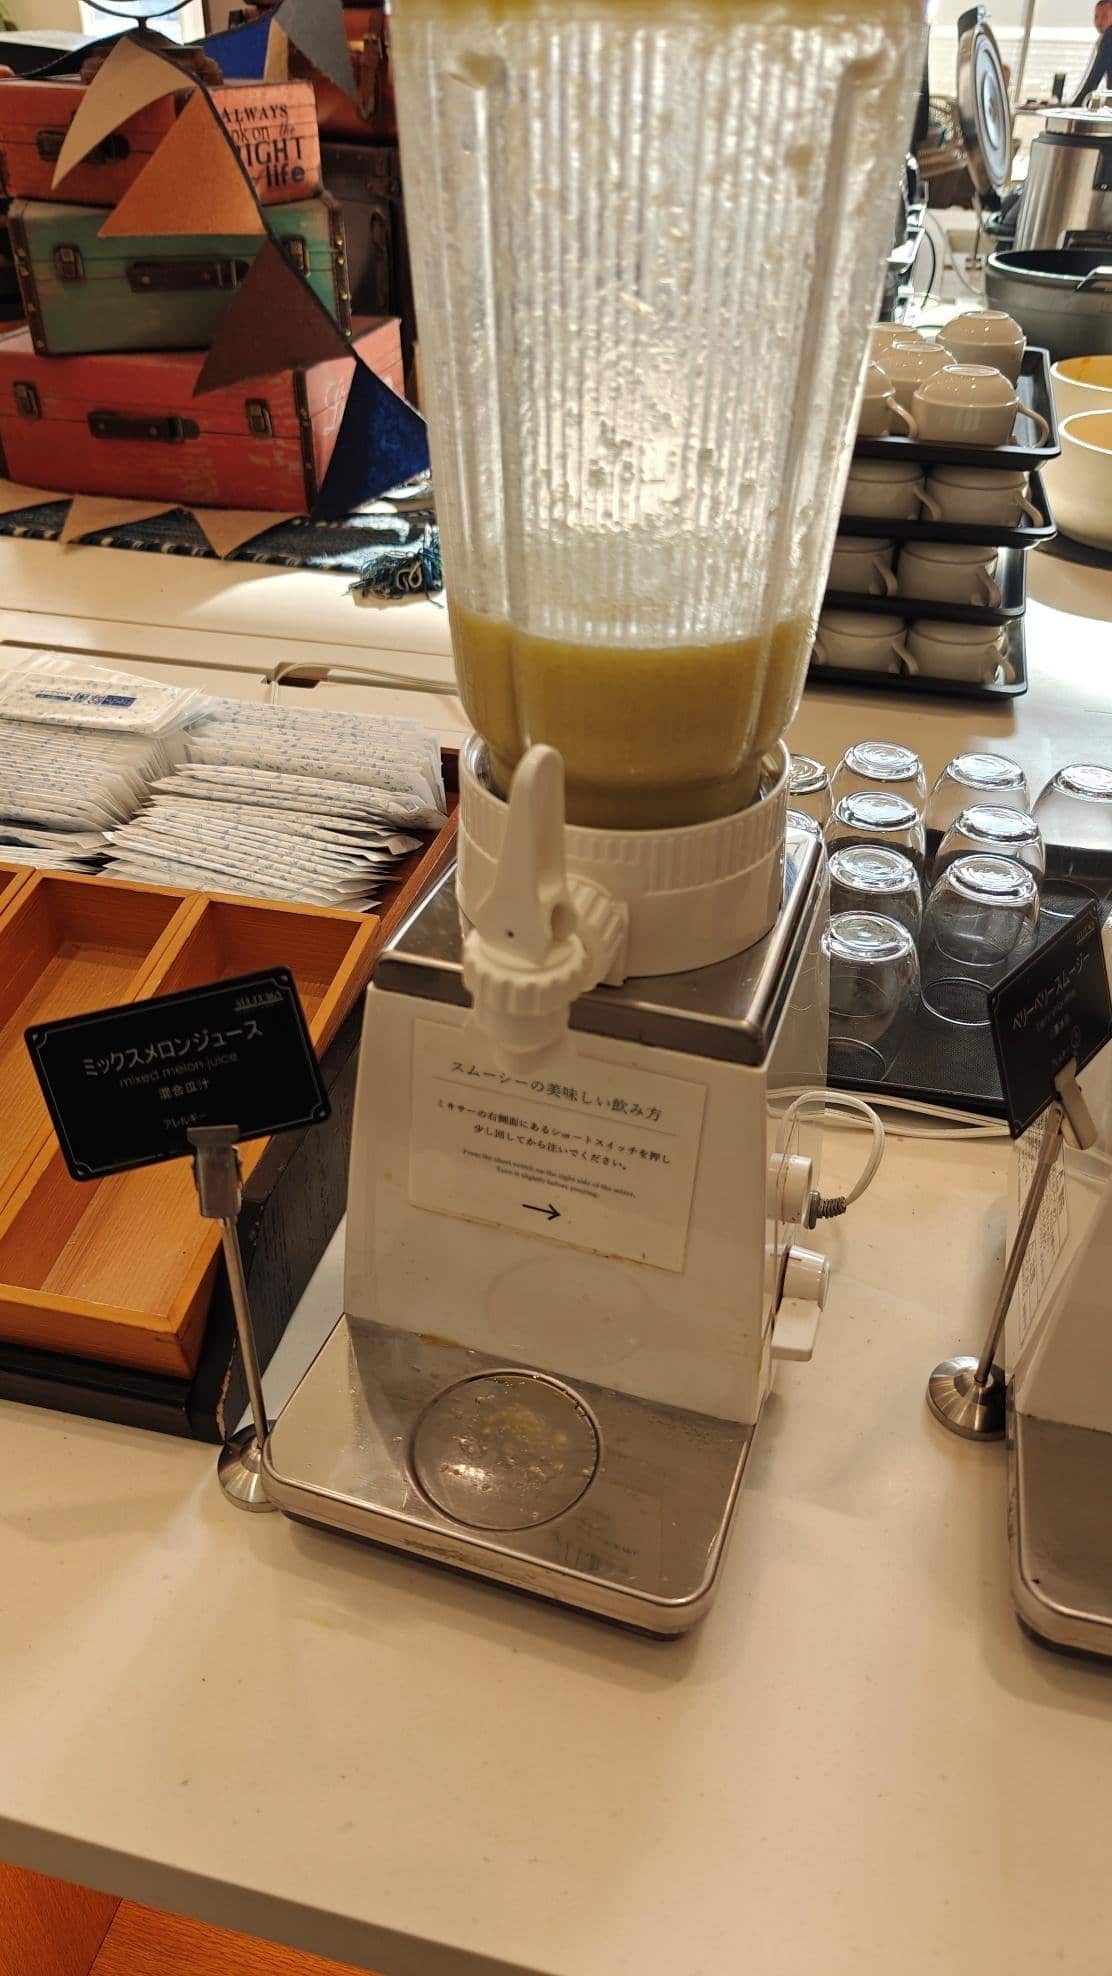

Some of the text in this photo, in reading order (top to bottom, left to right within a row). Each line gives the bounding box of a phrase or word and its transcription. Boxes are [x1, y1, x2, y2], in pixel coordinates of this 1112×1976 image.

[222, 104, 288, 123] ALWAYS
[236, 136, 304, 168] IGHT
[265, 163, 305, 188] life
[82, 1019, 263, 1077] ミックスメロンジュース
[119, 1069, 160, 1089] mixed
[162, 1059, 206, 1080] melon
